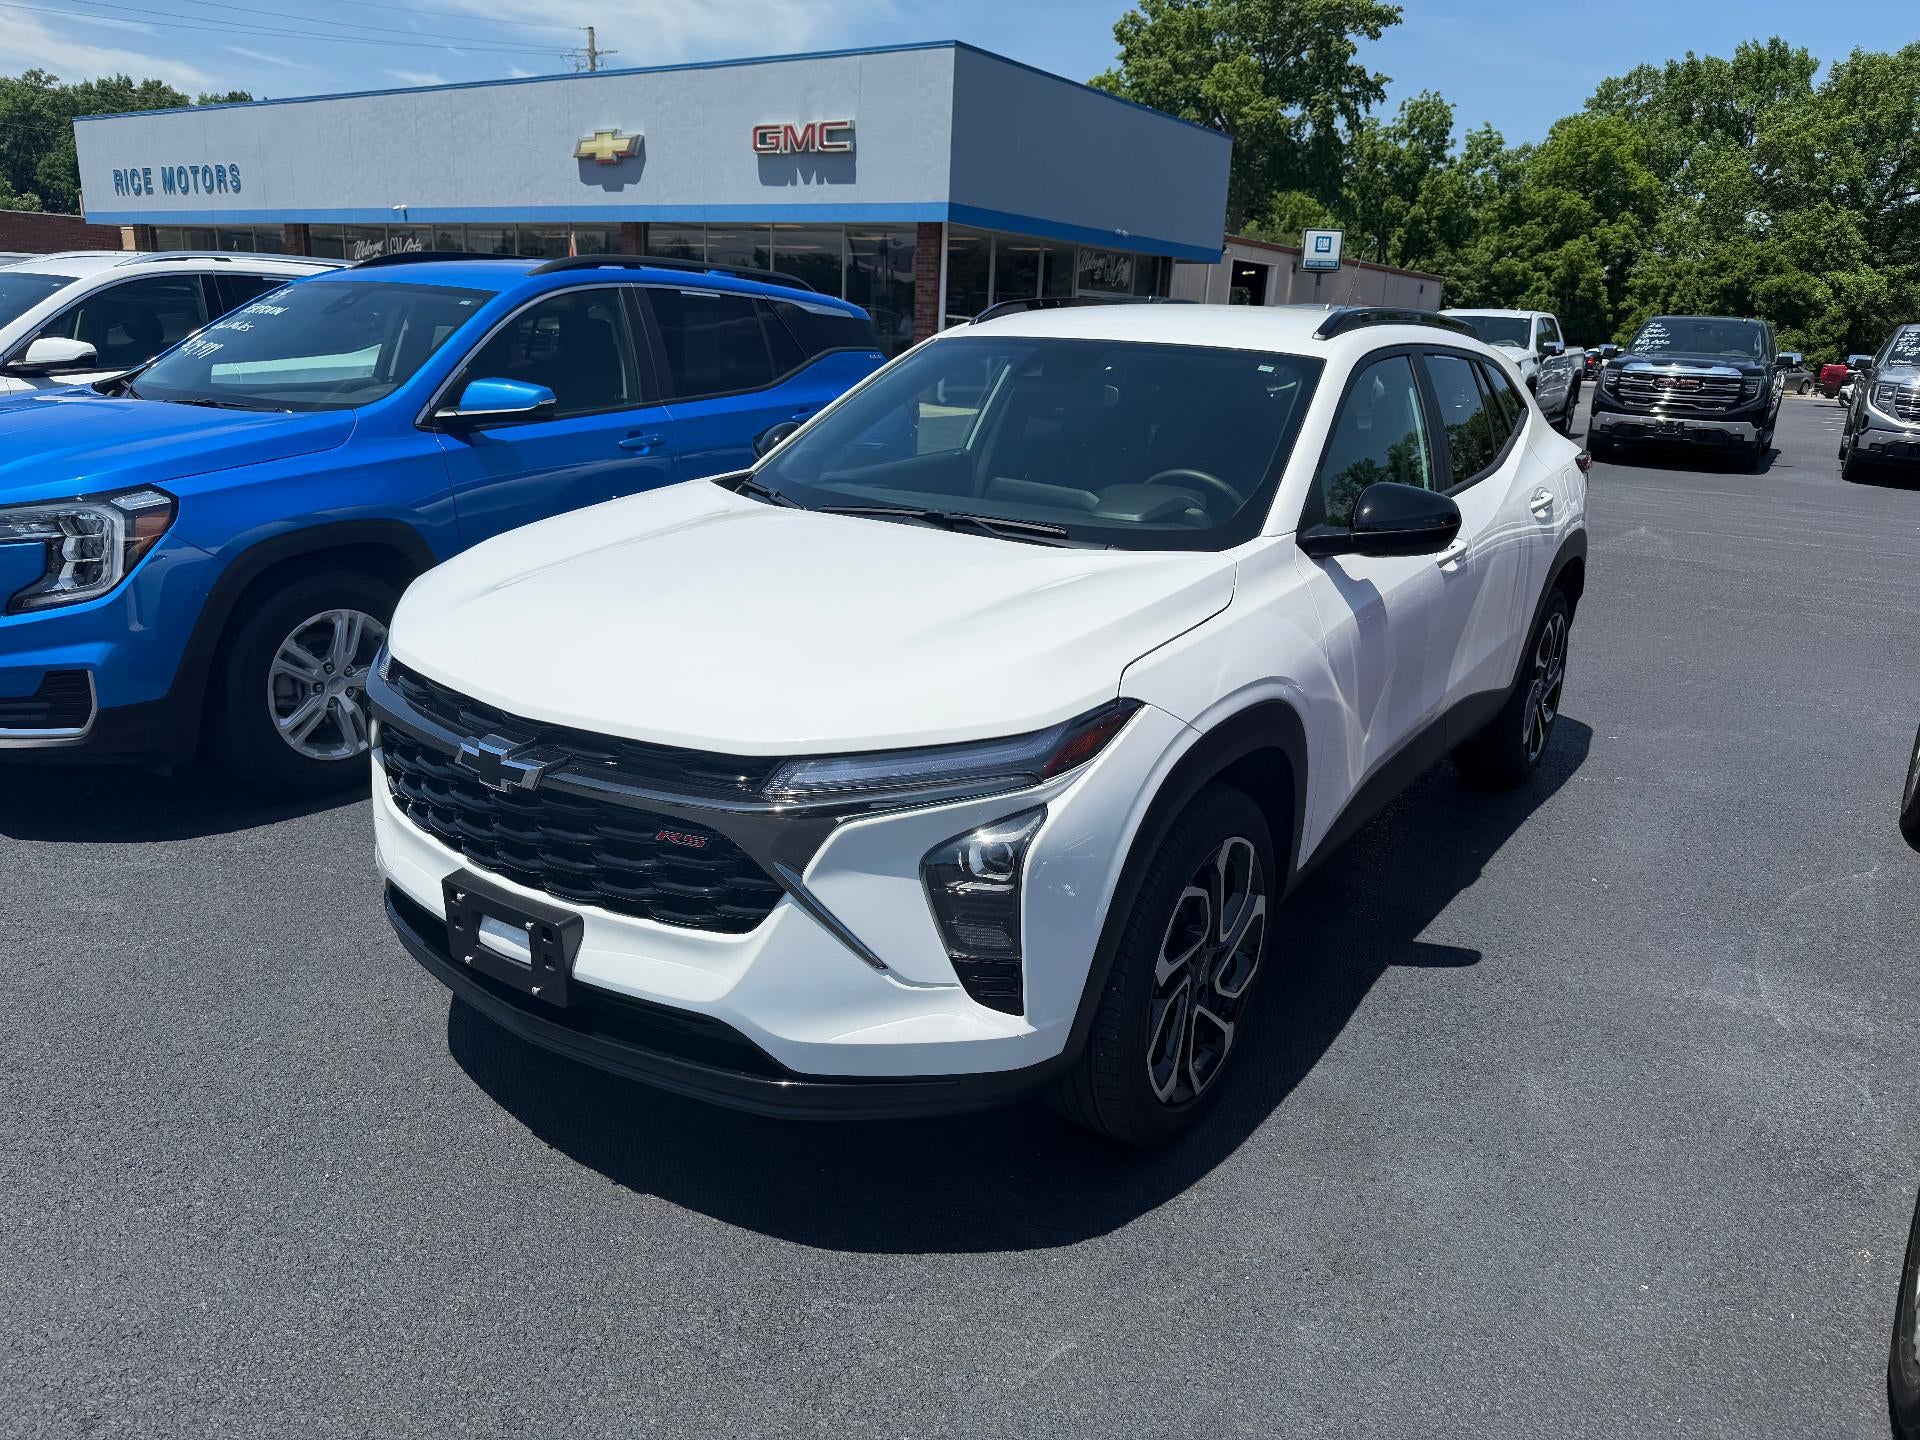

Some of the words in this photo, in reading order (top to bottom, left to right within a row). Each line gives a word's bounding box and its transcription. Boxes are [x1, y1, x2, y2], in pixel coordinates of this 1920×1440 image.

[753, 119, 854, 153] GMC
[113, 168, 153, 197] RICE
[161, 163, 241, 195] MOTORS
[1317, 236, 1330, 247] GM
[1656, 377, 1699, 388] GMC
[656, 830, 708, 848] RS
